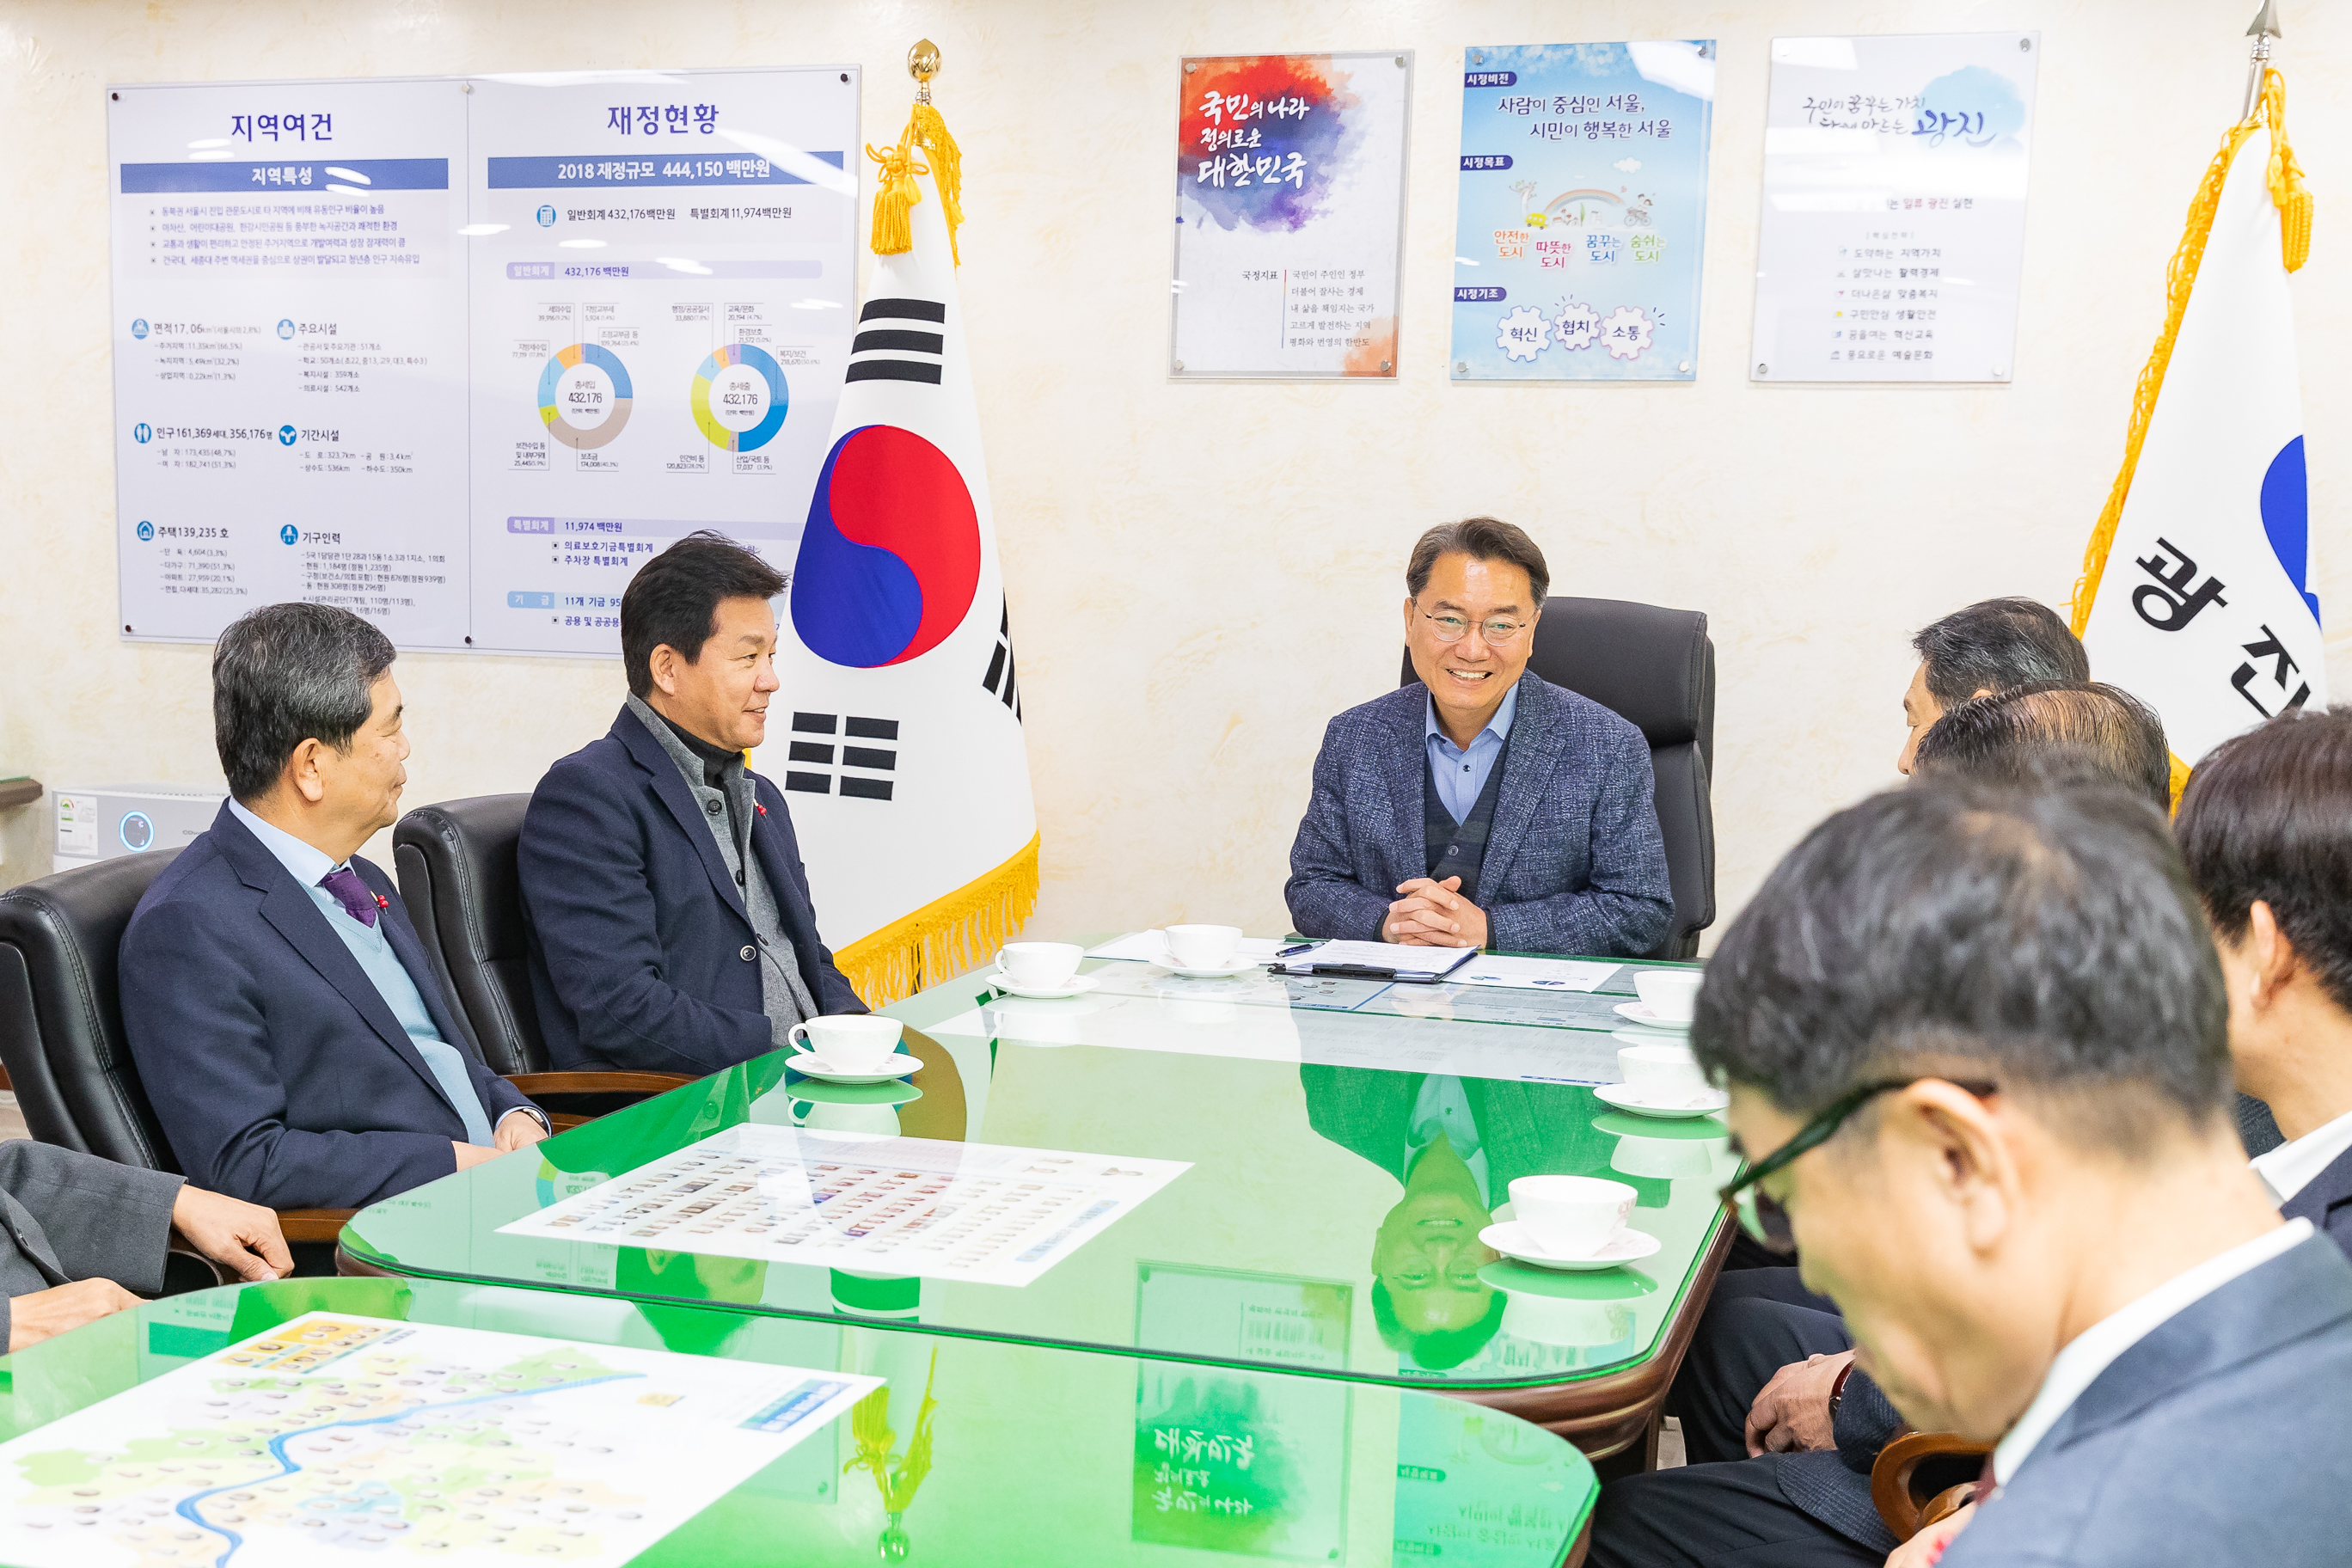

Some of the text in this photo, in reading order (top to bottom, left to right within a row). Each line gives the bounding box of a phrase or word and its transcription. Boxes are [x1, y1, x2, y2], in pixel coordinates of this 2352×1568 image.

[1467, 74, 1510, 85] 시정비전
[1198, 90, 1310, 126] 국민의 나라
[1498, 95, 1645, 115] 사람이 중심인 서울,
[607, 103, 720, 136] 재정현황
[231, 113, 333, 142] 지역여건
[1530, 119, 1671, 140] 시민이 행복한 서울
[1911, 110, 1997, 148] 광진
[1200, 127, 1262, 151] 정의로운
[1463, 156, 1505, 168] 시정목표
[558, 159, 770, 181] 2018 재정규모 444,150 백만원
[1197, 152, 1307, 189] 대한민국
[252, 167, 313, 186] 지역특성
[186, 206, 207, 216] 서울시
[273, 205, 295, 215] 지역에
[297, 205, 312, 214] 비해
[314, 205, 343, 215] 유동인구
[346, 205, 367, 214] 비율이
[567, 208, 606, 222] 일반회계
[690, 208, 729, 219] 특별회계
[358, 222, 380, 231] 쾌적한
[383, 221, 397, 231] 환경
[1494, 230, 1529, 244] 안전한
[1586, 235, 1621, 248] 꿈꾸는
[1631, 235, 1666, 248] 숨쉬는
[350, 238, 364, 248] 성장
[1536, 241, 1571, 254] 따뜻한
[1498, 247, 1523, 258] 도시
[1590, 251, 1615, 262] 도시
[1635, 251, 1659, 262] 도시
[373, 254, 387, 264] 인구
[390, 254, 420, 264] 지속유입
[1540, 258, 1565, 268] 도시
[565, 267, 601, 277] 432,176
[603, 266, 628, 277] 백만원
[1242, 271, 1277, 280] 국정지표
[1293, 270, 1364, 279] 국민이 주인인 정부
[1292, 287, 1363, 297] 더불어 잘사는 경제
[1457, 289, 1498, 300] 시정기조
[1291, 304, 1374, 313] 내 삶을 책임지는 국가
[155, 323, 172, 334] 면적
[298, 323, 337, 335] 주요시설
[1290, 321, 1371, 330] 고르게 발전하는 지역
[1563, 320, 1589, 334] 협치
[1510, 328, 1537, 342] 혁신
[1613, 327, 1640, 340] 소통
[1289, 338, 1369, 346] 평화와 번영의 한반도
[575, 381, 596, 389] 총세입
[568, 393, 602, 403] 432,176
[723, 395, 757, 405] 432,176
[156, 428, 175, 438] 인구
[301, 430, 339, 442] 기간시설
[513, 519, 622, 533] 특별회계 11,974 백만원
[220, 529, 229, 538] 호
[303, 532, 340, 544] 기구인력
[565, 542, 652, 553] 의료보호기금특별회계
[565, 555, 628, 567] 주차장 특별회계
[565, 597, 605, 607] 11개 기금
[565, 616, 591, 627] 공용 및
